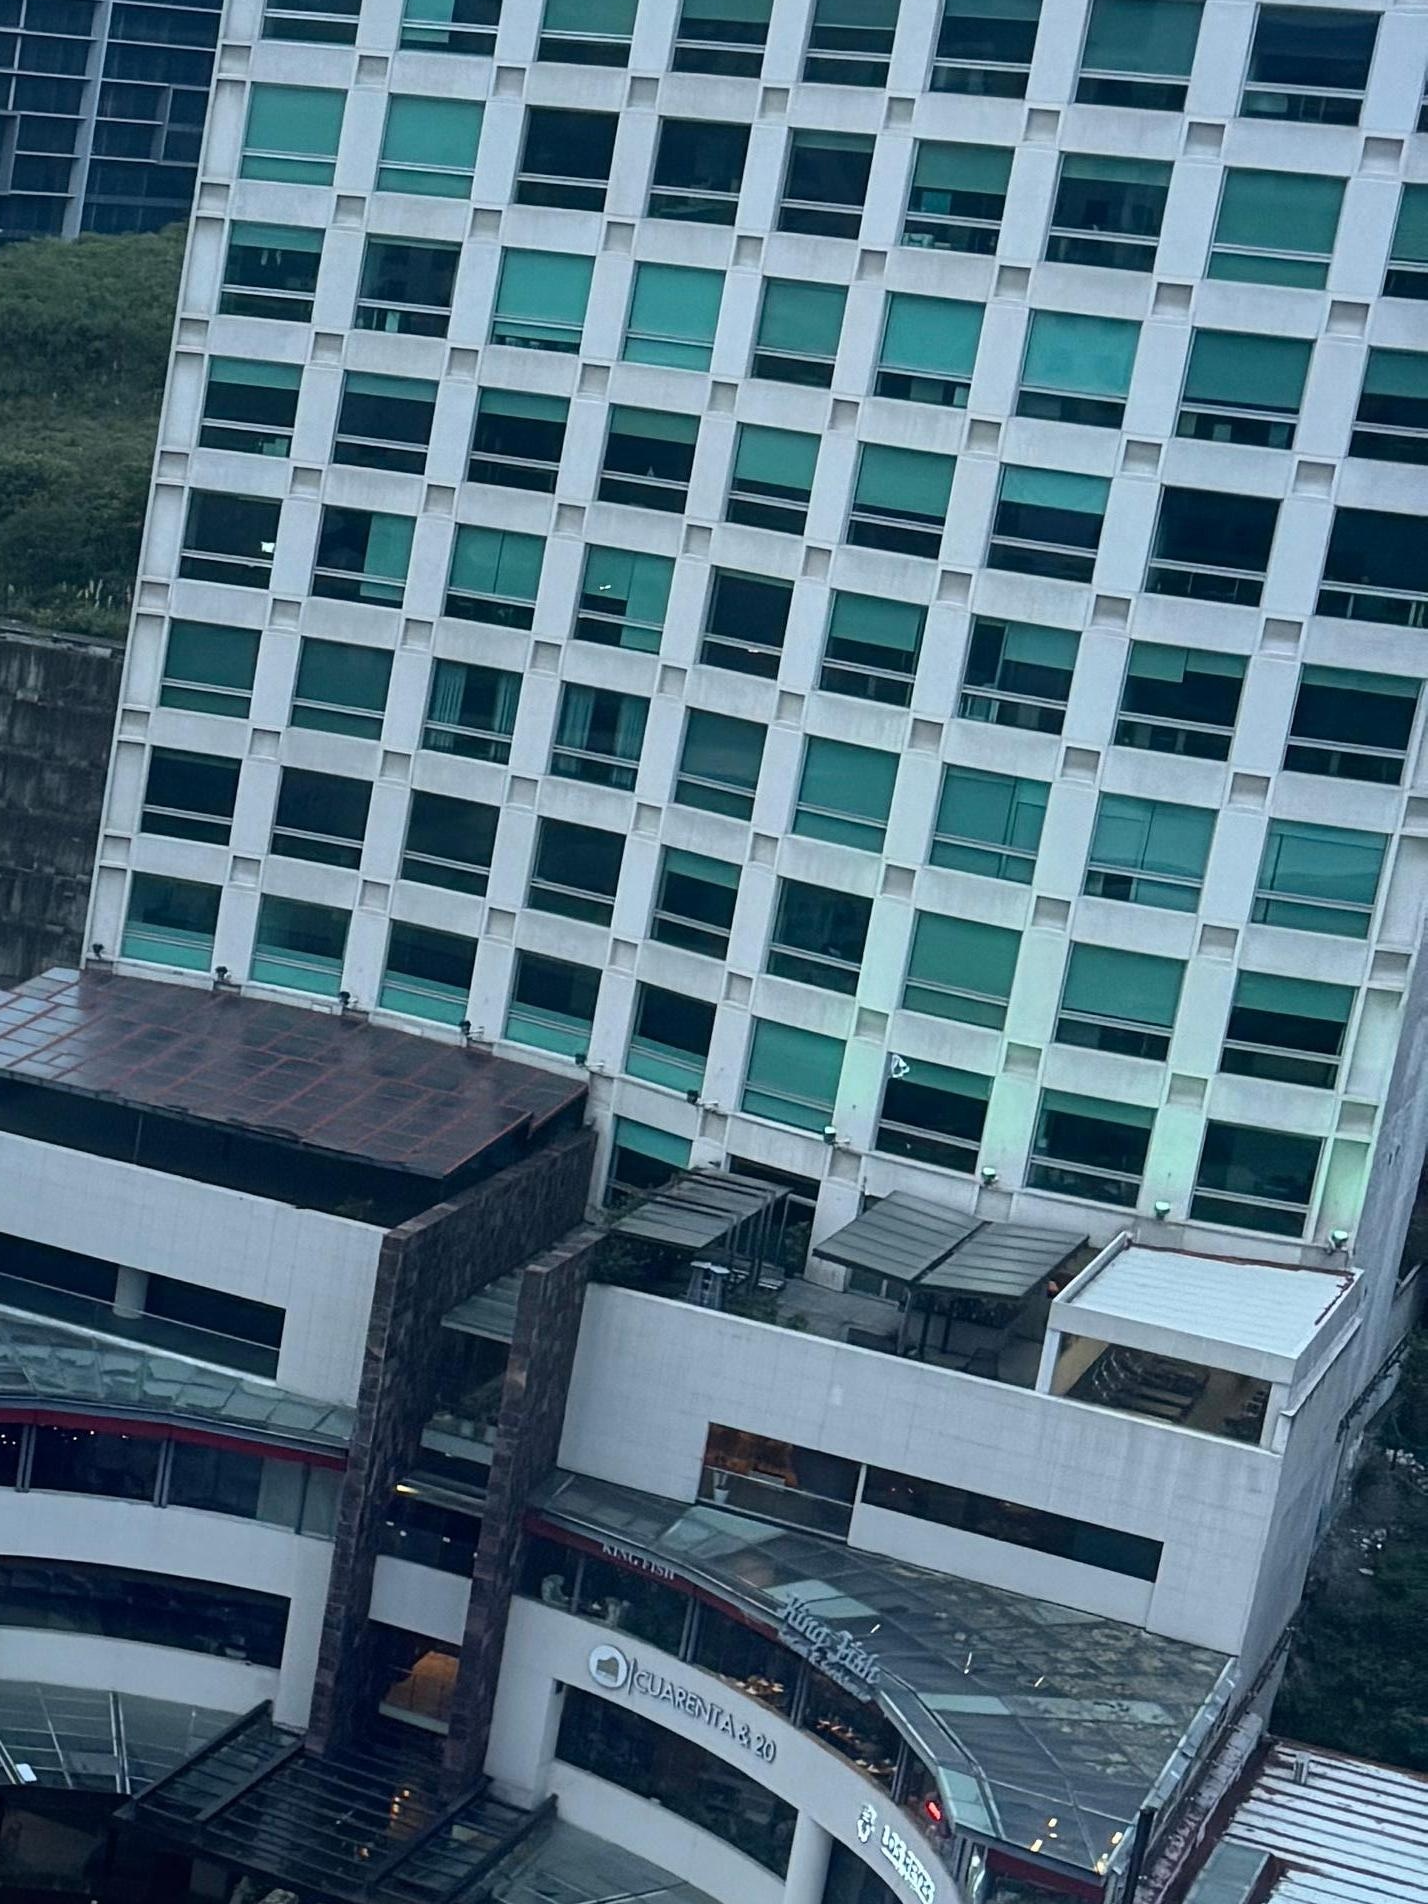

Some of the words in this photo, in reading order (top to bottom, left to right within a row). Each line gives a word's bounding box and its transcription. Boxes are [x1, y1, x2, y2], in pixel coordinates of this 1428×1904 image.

[602, 1544, 638, 1567] KING
[641, 1557, 676, 1581] FISH
[633, 1670, 735, 1739] CUARENTA
[755, 1733, 777, 1764] 20
